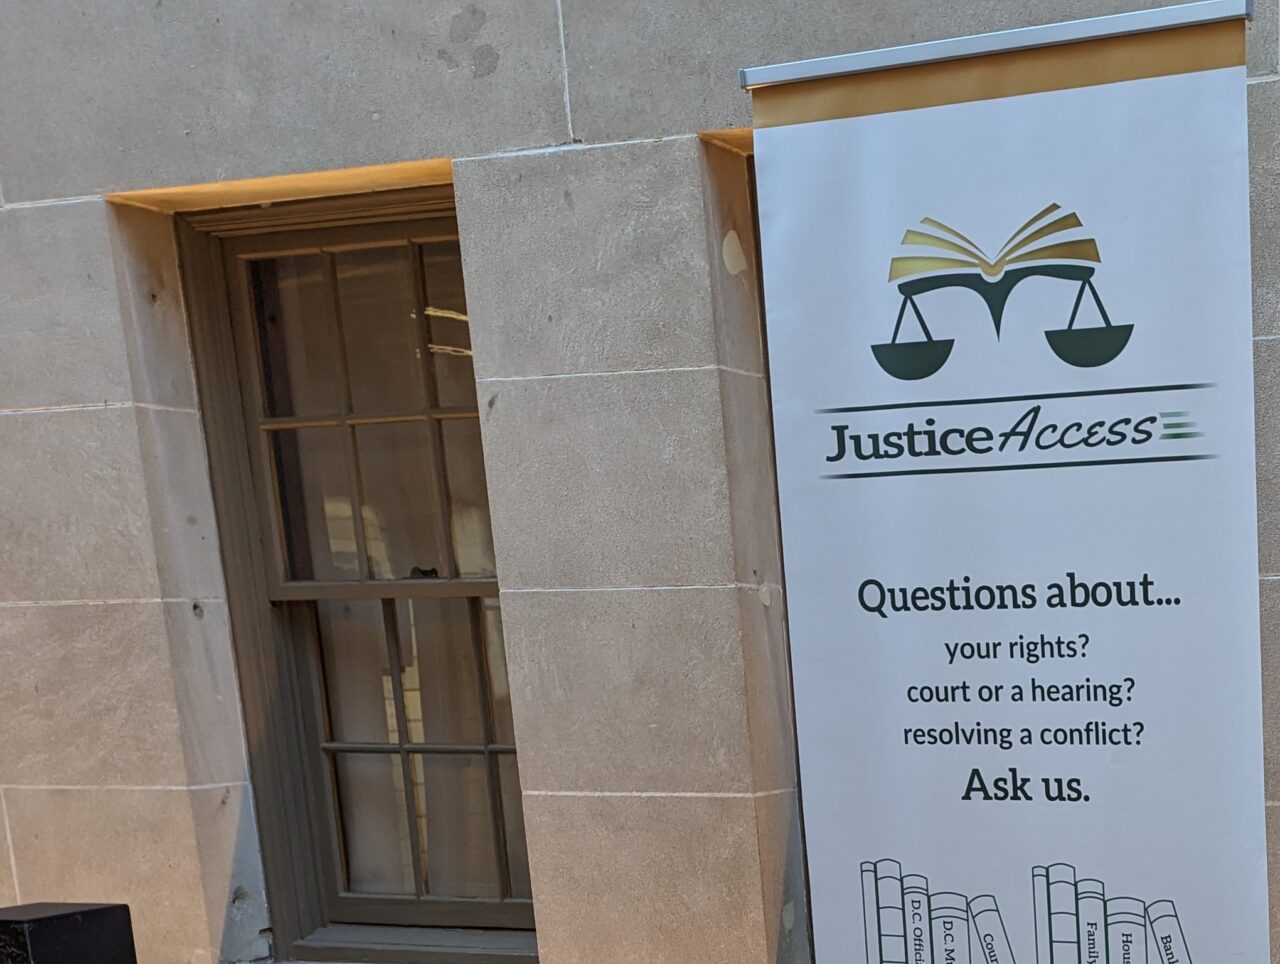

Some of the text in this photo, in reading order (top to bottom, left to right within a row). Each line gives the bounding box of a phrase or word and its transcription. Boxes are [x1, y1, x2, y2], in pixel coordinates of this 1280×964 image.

[857, 573, 1181, 618] Questions about...
[944, 634, 1090, 665] your rights?
[907, 677, 1136, 707] court or a hearing?
[903, 721, 1145, 750] resolving a conflict?
[961, 768, 1091, 802] Ask us.
[911, 899, 922, 924] D.C.
[942, 920, 955, 945] D.C.
